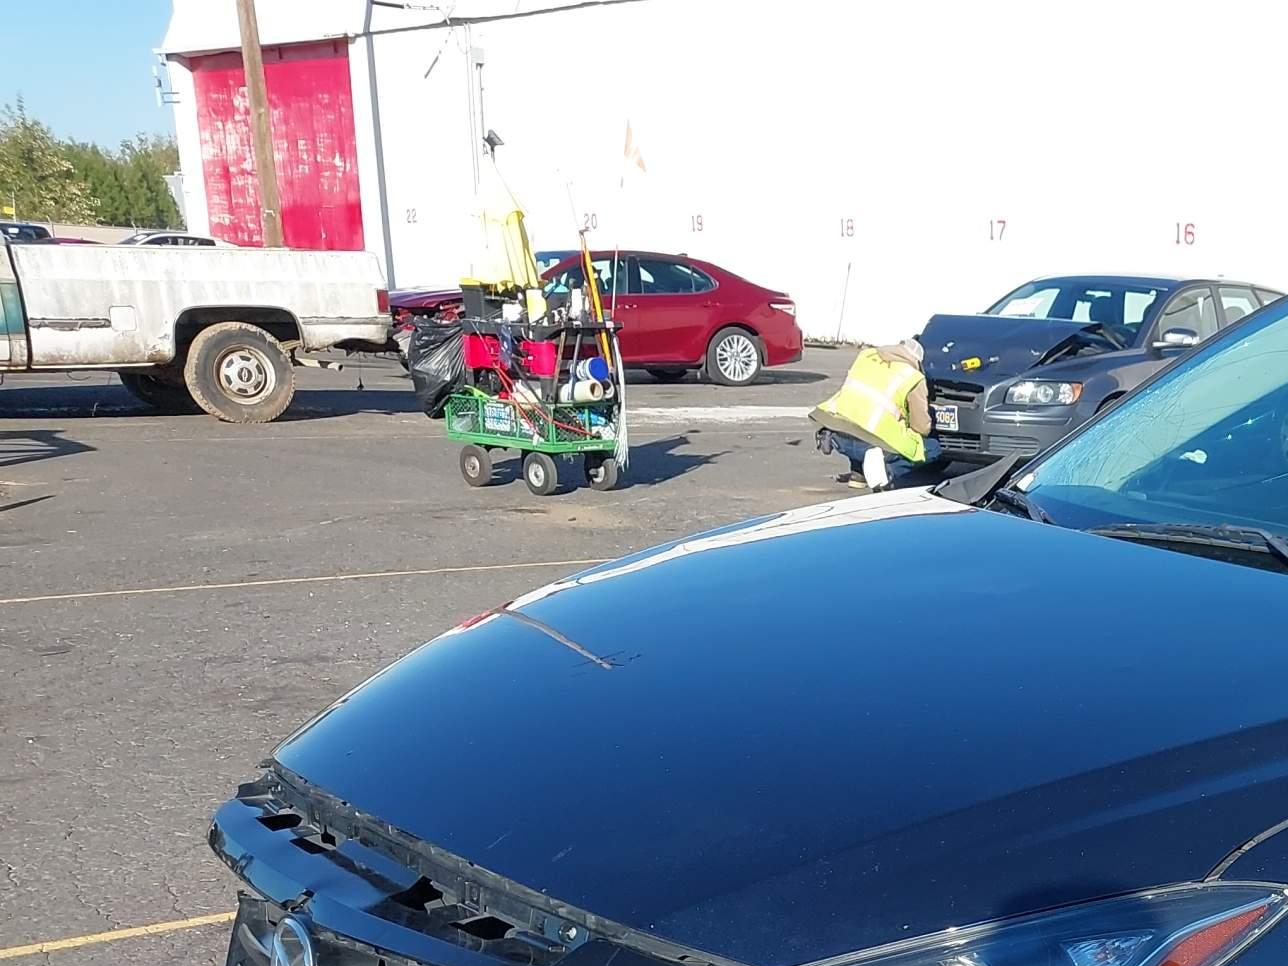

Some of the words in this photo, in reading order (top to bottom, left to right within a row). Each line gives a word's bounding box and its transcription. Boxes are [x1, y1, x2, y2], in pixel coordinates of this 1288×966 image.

[583, 212, 598, 230] 20
[691, 214, 703, 232] 19
[841, 218, 854, 237] 18
[989, 219, 1006, 240] 17
[1176, 222, 1195, 245] 16
